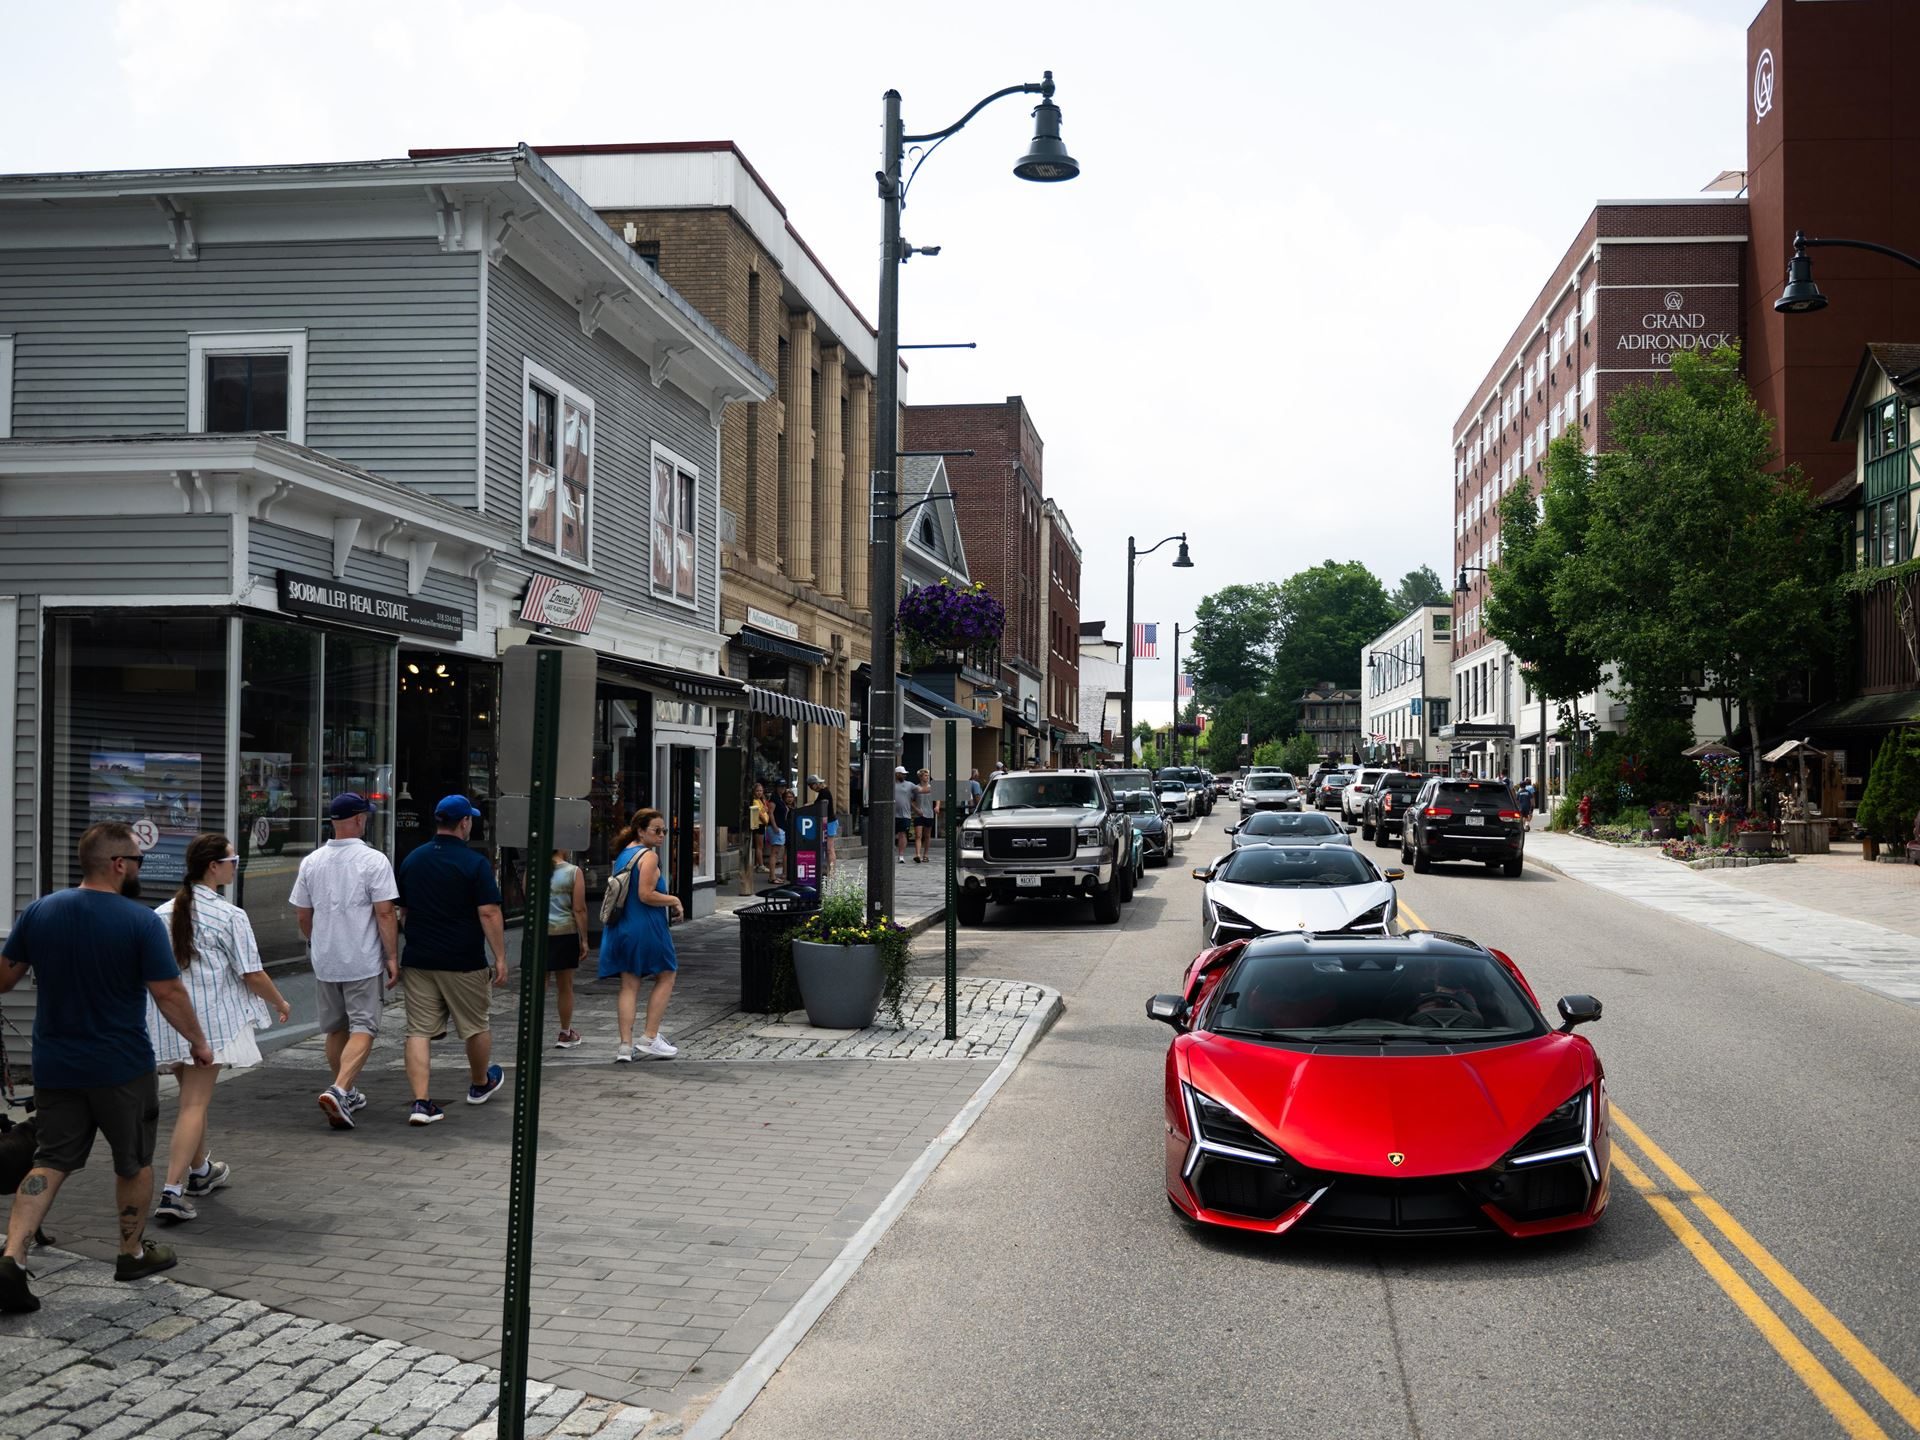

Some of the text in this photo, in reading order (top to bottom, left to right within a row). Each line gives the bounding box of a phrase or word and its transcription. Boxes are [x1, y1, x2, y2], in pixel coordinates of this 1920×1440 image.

[1642, 313, 1705, 329] GRAND
[1617, 333, 1731, 349] ADIRONDACK
[549, 589, 574, 606] Emma's
[349, 594, 375, 616] REAL
[375, 599, 409, 622] ESTATE
[802, 818, 813, 836] P
[1011, 838, 1048, 848] GMC
